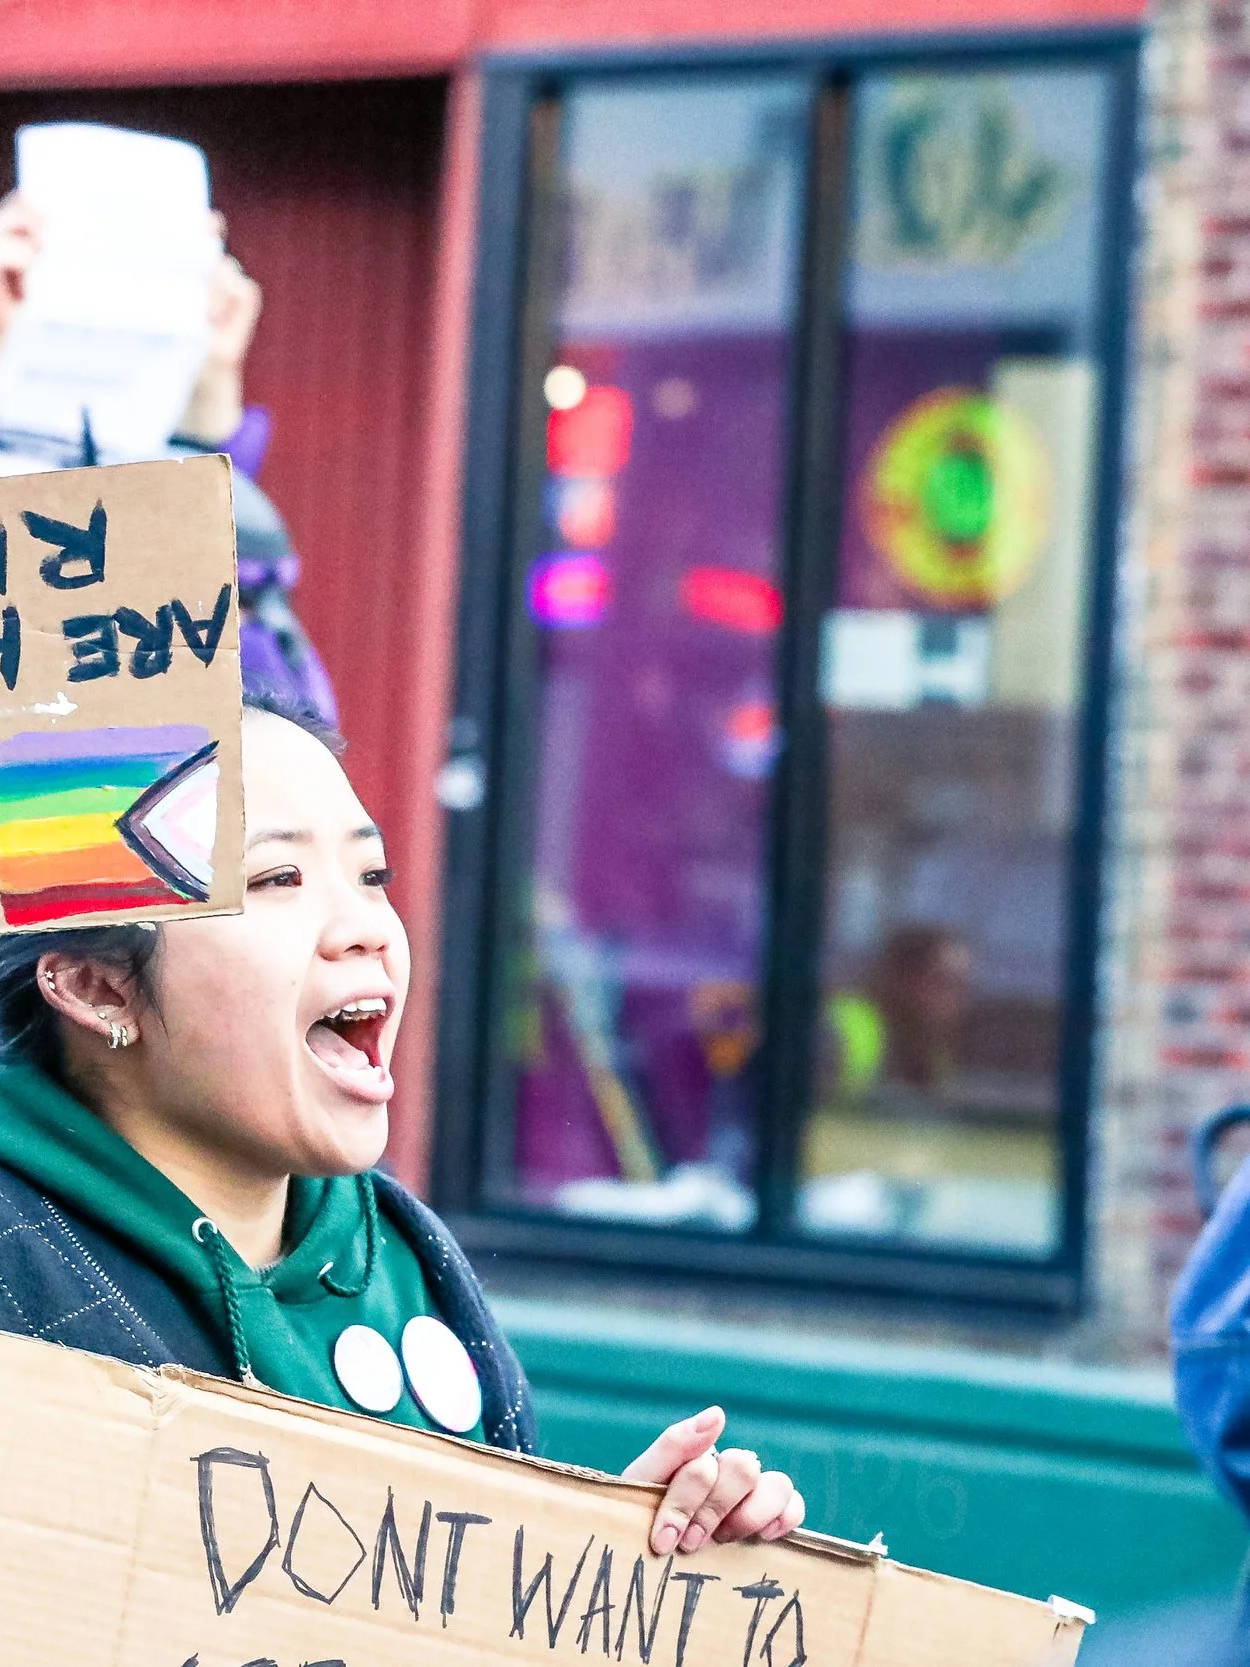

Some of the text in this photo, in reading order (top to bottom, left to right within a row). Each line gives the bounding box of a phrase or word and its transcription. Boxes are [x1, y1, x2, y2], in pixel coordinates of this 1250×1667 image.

[63, 584, 232, 682] ARE
[190, 1446, 808, 1667] DONT WANT TO
